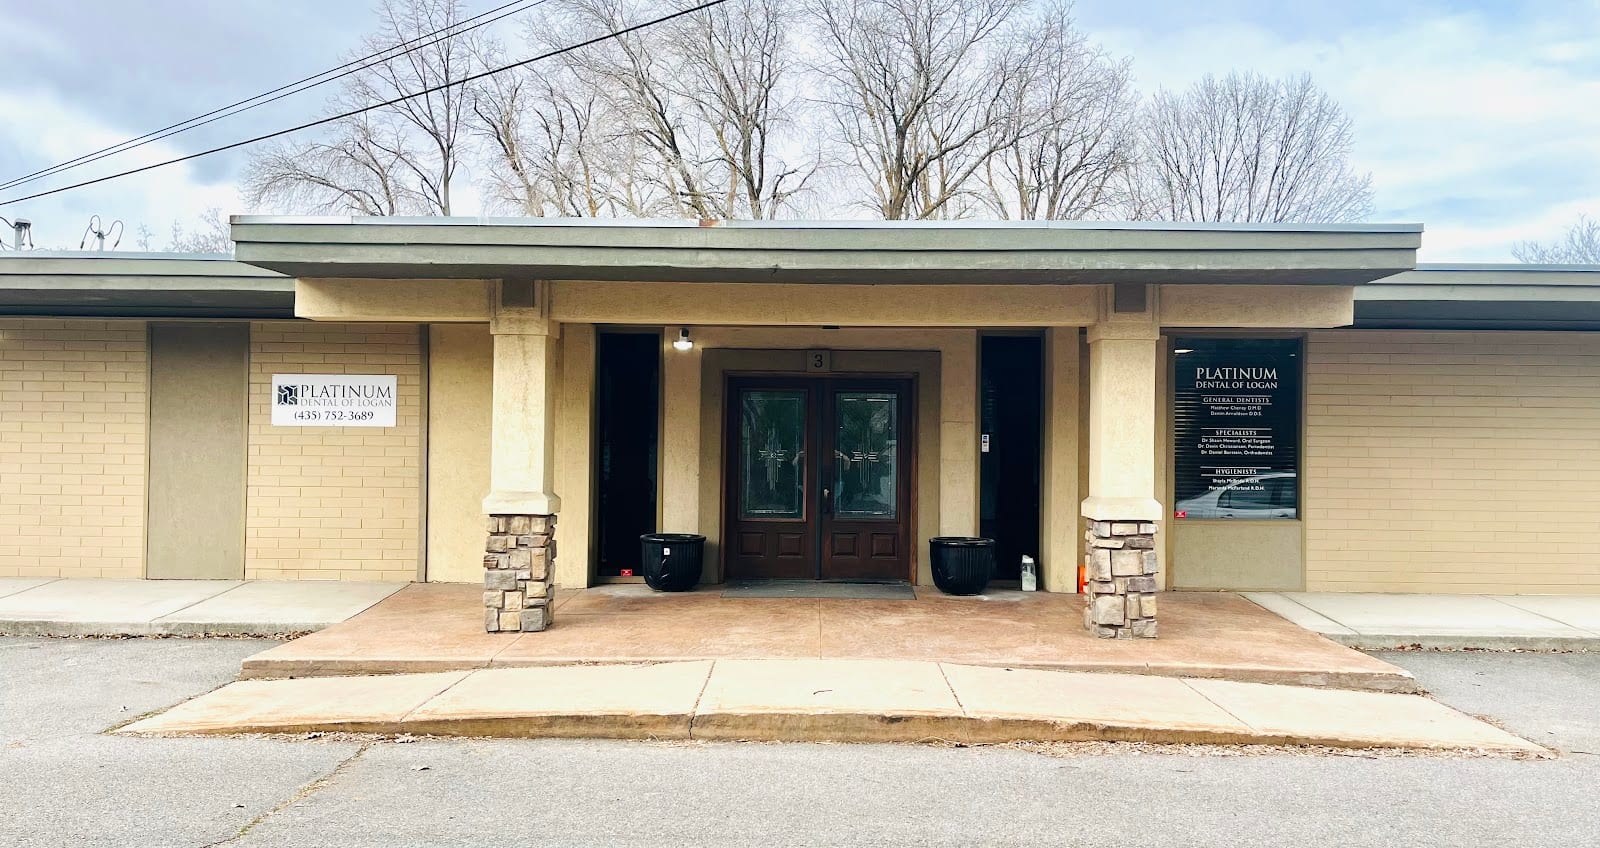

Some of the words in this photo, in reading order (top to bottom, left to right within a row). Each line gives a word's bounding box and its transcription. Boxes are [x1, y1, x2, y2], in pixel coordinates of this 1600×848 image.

[814, 354, 823, 368] 3
[1196, 367, 1278, 380] PLATINUM
[1195, 381, 1230, 389] DENTAL
[1231, 381, 1245, 389] OF
[1246, 381, 1278, 389] LOGAN
[301, 384, 392, 399] PLATINUM
[300, 399, 339, 407] DENTAL
[341, 399, 353, 407] OF
[357, 399, 392, 407] LOGAN
[294, 410, 321, 421] (435)
[324, 410, 374, 421] 752-3689
